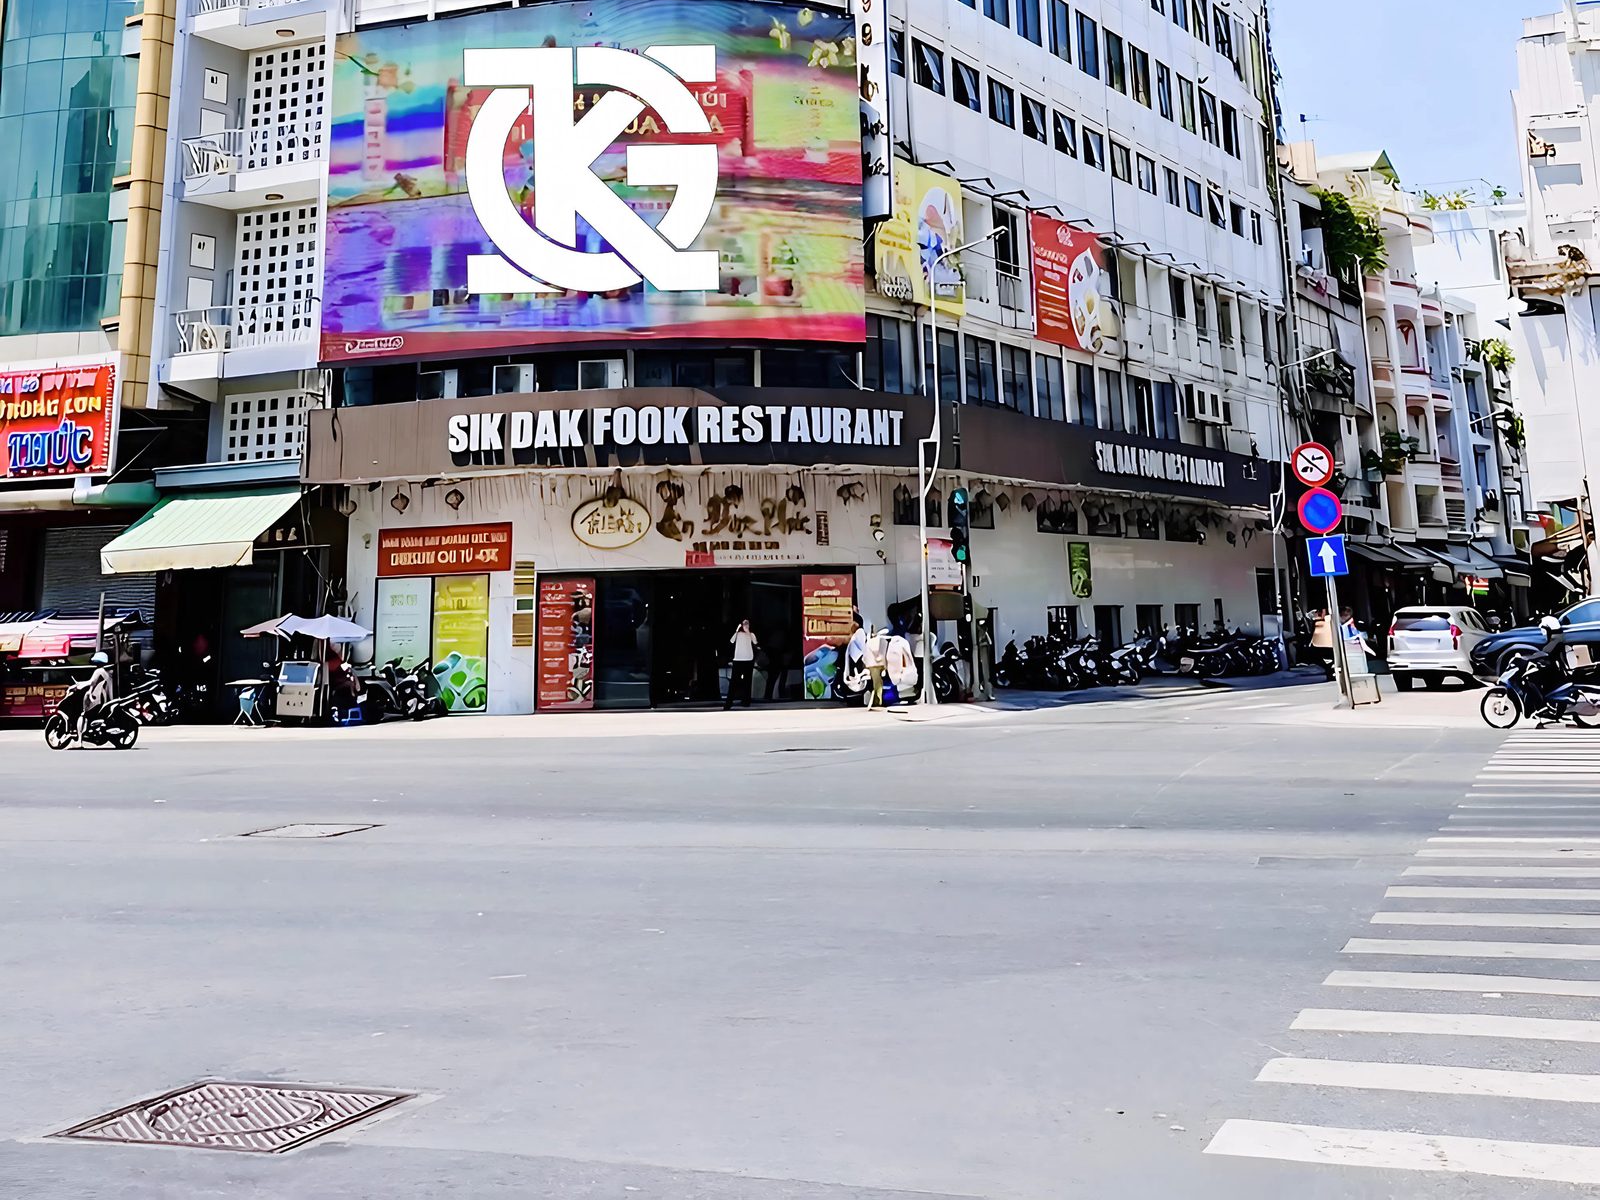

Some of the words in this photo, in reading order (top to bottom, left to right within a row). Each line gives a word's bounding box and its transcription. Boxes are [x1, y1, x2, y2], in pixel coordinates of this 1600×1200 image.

[448, 413, 505, 453] SIK
[511, 408, 584, 450] DAK
[593, 406, 690, 446] FOOK
[698, 404, 904, 446] RESTAURANT
